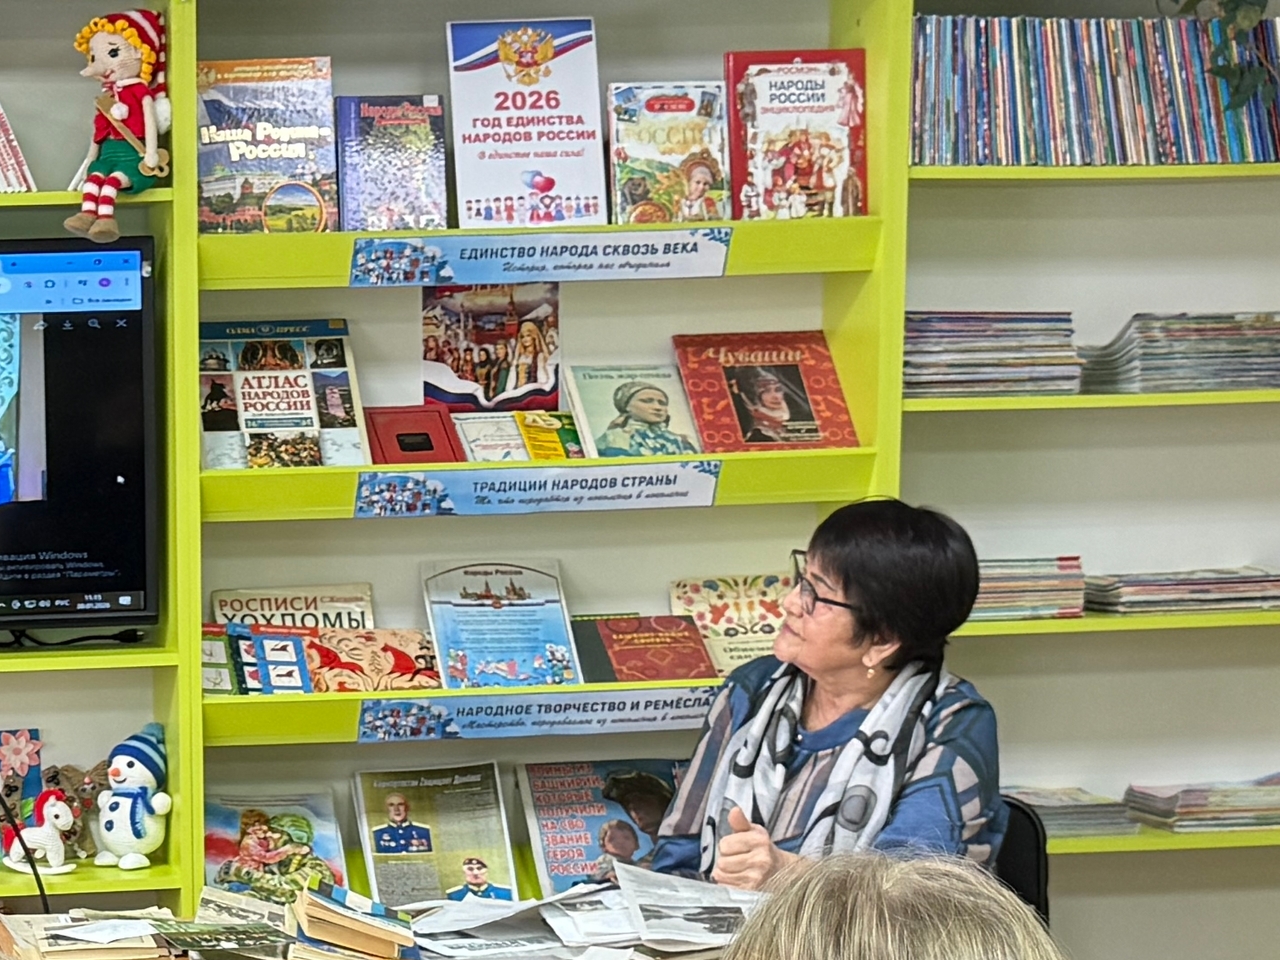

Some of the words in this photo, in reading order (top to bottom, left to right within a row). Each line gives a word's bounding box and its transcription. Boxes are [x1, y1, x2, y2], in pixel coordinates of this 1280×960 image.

[769, 80, 826, 93] НАРОДЫ
[494, 90, 561, 112] 2026
[770, 92, 826, 104] РОССИИ
[472, 118, 503, 130] ГОД
[506, 115, 585, 127] ЕДИНСТВА
[200, 124, 252, 145] Наша
[462, 131, 533, 145] НАРОДОВ
[537, 130, 597, 142] РОССИИ
[460, 246, 537, 261] ЕДИНСТВО
[540, 244, 598, 258] НАРОДА
[603, 243, 659, 257] СКВОЗЬ
[663, 242, 699, 255] ВЕКА
[705, 348, 803, 365] Чуваши
[241, 375, 308, 389] АТЛАС
[241, 389, 311, 401] НАРОДОВ
[243, 400, 312, 412] РОССИИ
[473, 481, 548, 494] ТРАДИЦИИ
[551, 477, 617, 491] НАРОДОВ
[621, 475, 678, 488] СТРАНЫ
[39, 551, 88, 560] Windows
[219, 596, 318, 612] РОСПИСИ
[222, 610, 366, 629] ХОХЛОМЫ
[457, 703, 533, 717] НАРОДНОЕ
[537, 700, 626, 714] ТВОРЧЕСТВО
[630, 699, 640, 711] И
[533, 775, 605, 790] БАШКИРИИ,
[535, 790, 593, 804] КОТОРЫЕ
[538, 803, 607, 818] ПОЛУЧИЛИ
[542, 820, 558, 832] НА
[561, 818, 586, 832] СВО
[545, 832, 591, 846] ЗВАНИЕ
[547, 848, 585, 860] ГЕРОЯ
[550, 861, 600, 875] РОССИИ
